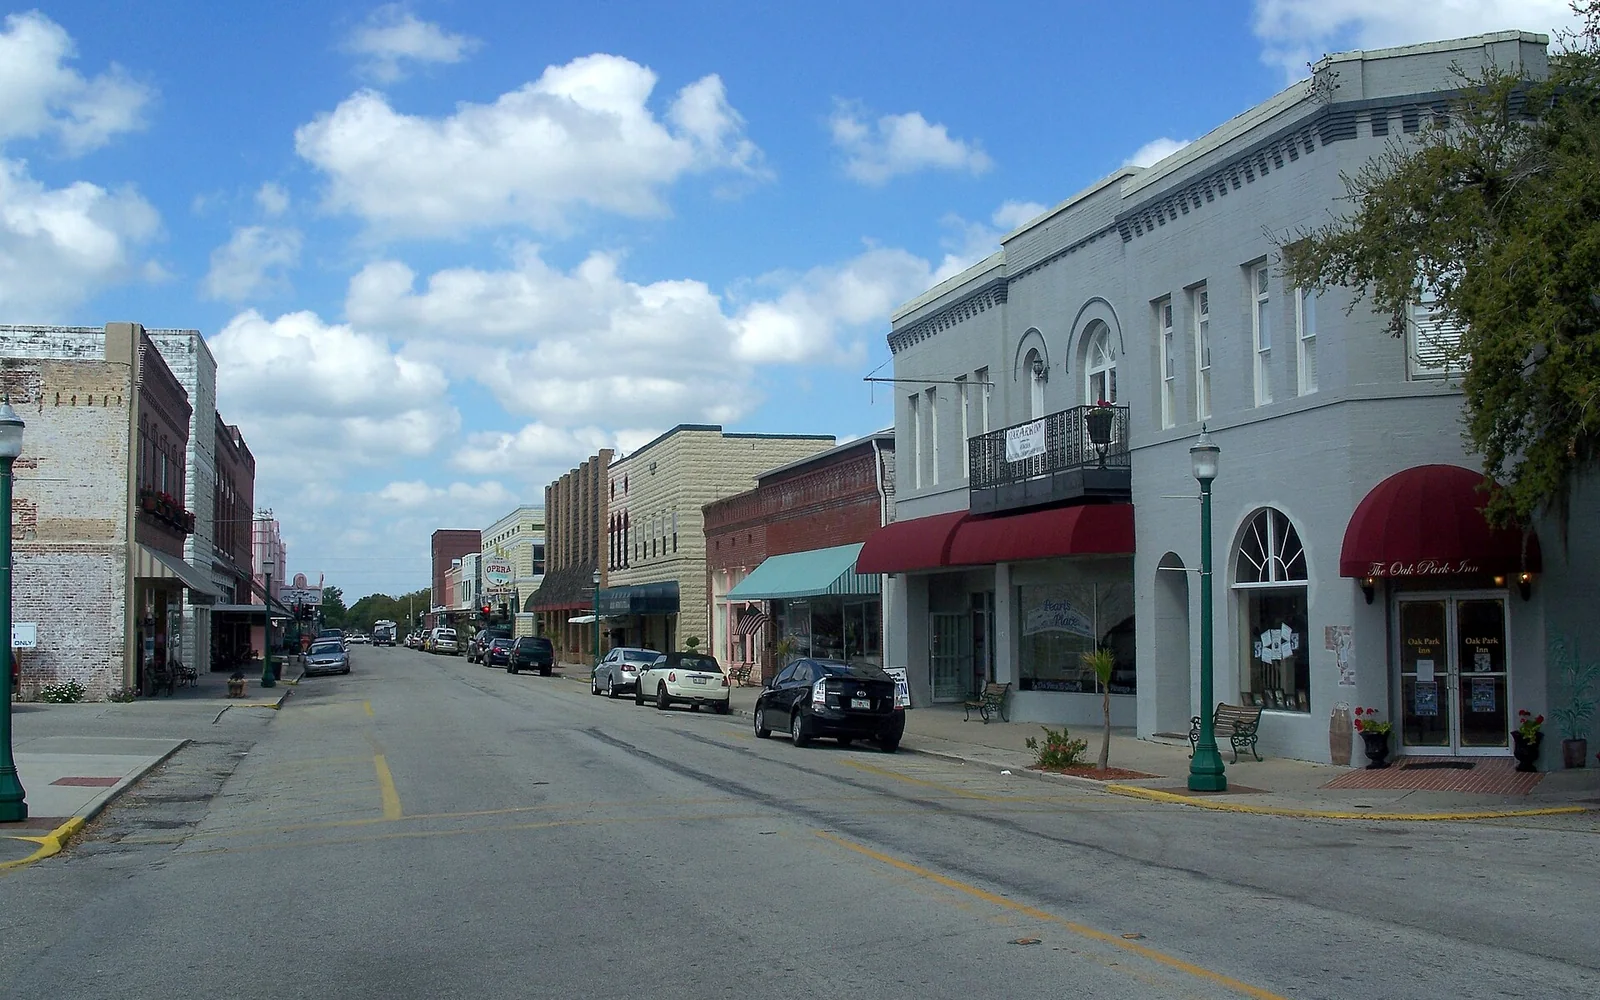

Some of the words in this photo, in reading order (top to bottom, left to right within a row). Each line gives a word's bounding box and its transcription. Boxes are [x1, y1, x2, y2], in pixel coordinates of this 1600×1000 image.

[486, 565, 511, 573] OPERA
[1367, 561, 1386, 577] The
[1389, 561, 1414, 576] Oak
[1417, 559, 1450, 575] Park
[1452, 558, 1480, 574] Inn
[1054, 613, 1080, 626] Place
[1408, 637, 1423, 645] Oak
[1424, 637, 1440, 645] Park
[1465, 637, 1481, 645] Oak
[1482, 637, 1499, 645] Park
[1418, 646, 1431, 654] Inn
